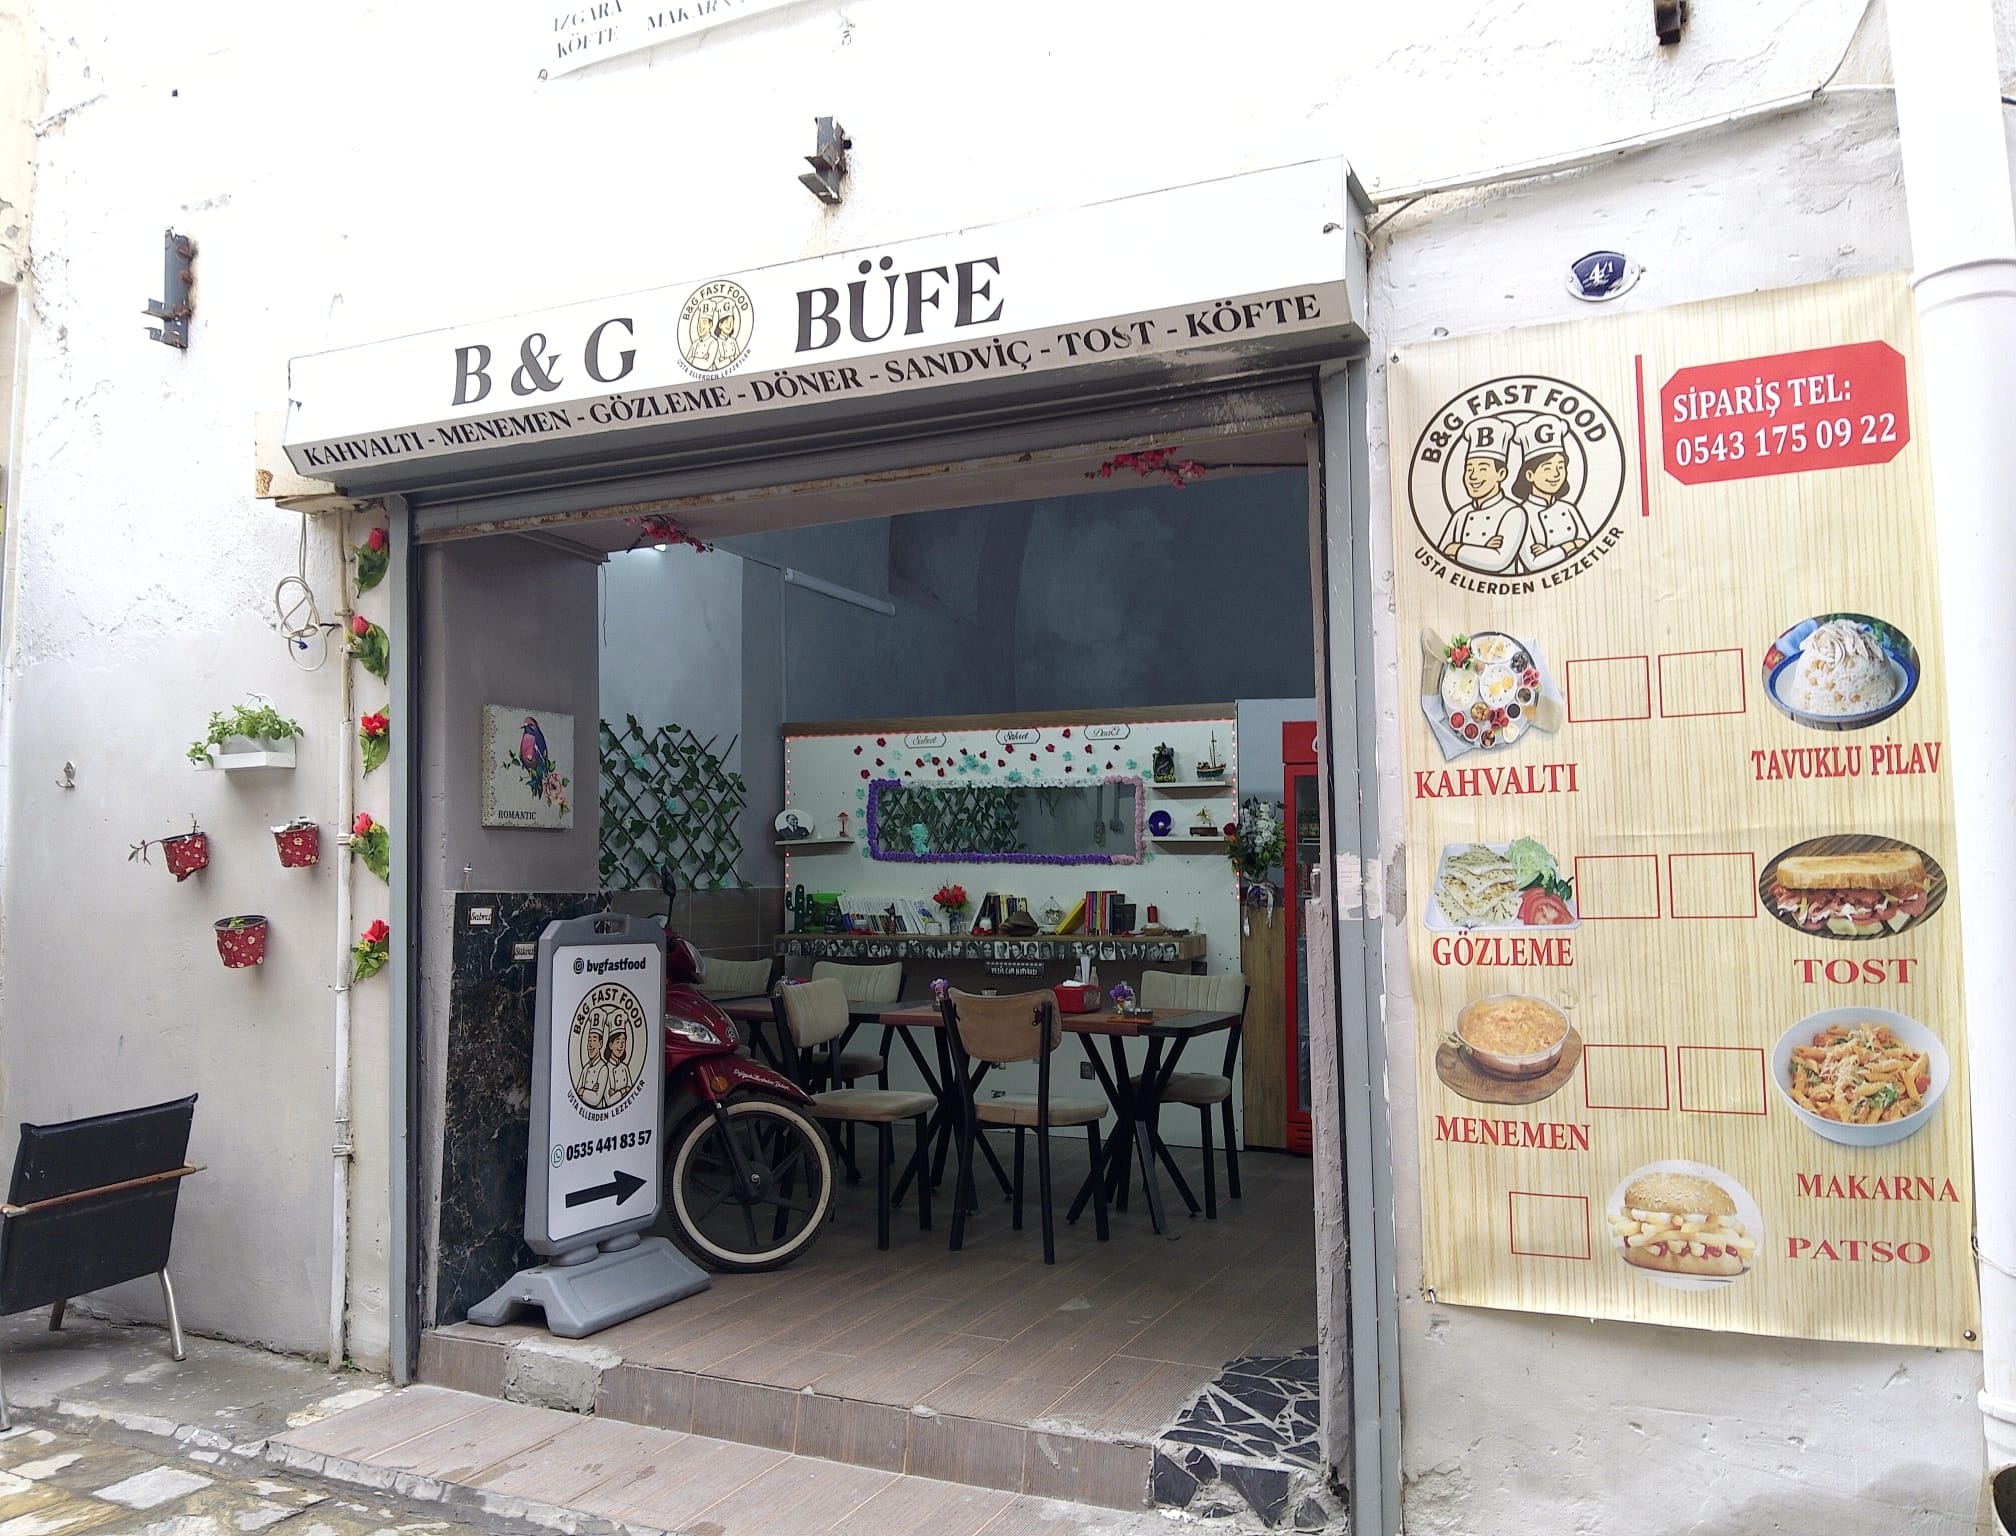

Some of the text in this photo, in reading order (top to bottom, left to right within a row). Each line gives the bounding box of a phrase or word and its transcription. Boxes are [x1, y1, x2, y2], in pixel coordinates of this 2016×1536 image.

[682, 284, 748, 321] B&G FAST FOOD
[723, 301, 730, 311] G
[452, 255, 1005, 406] B & G BÜFE
[303, 431, 425, 467] KAHVALTI
[437, 408, 573, 447] MENEMEN
[590, 385, 730, 424] GÖZLEME
[756, 366, 862, 402] DÖNER
[885, 337, 1032, 383] SANDVİÇ
[1057, 319, 1156, 357] TOST
[1188, 294, 1322, 338] KÖFTE
[1672, 374, 1852, 424] SİPARİŞ TEL:
[1421, 384, 1608, 464] B&G FAST FOOD
[1475, 423, 1556, 447] B G
[1675, 412, 1897, 466] 0543 175 09 22
[1414, 526, 1625, 596] USTA ELLERDEN LEZZETLER
[1751, 737, 1942, 781] TAVUKLU PİLAV
[1414, 763, 1580, 800] KAHVALTI
[498, 810, 537, 821] ROMANTIC
[587, 957, 647, 975] bvgfastfood
[1431, 931, 1574, 968] GÖZLEME
[1793, 958, 1919, 985] TOST
[573, 988, 643, 1035] B&G FAST FOOD
[593, 1012, 623, 1027] B G
[567, 1078, 646, 1122] USTA ELLERDEN LEZZETLER
[566, 1129, 652, 1161] 0535 441 83 57
[1435, 1115, 1591, 1151] MENEMEN
[1795, 1173, 1960, 1203] MAKARNA
[1786, 1237, 1931, 1265] PATSO
